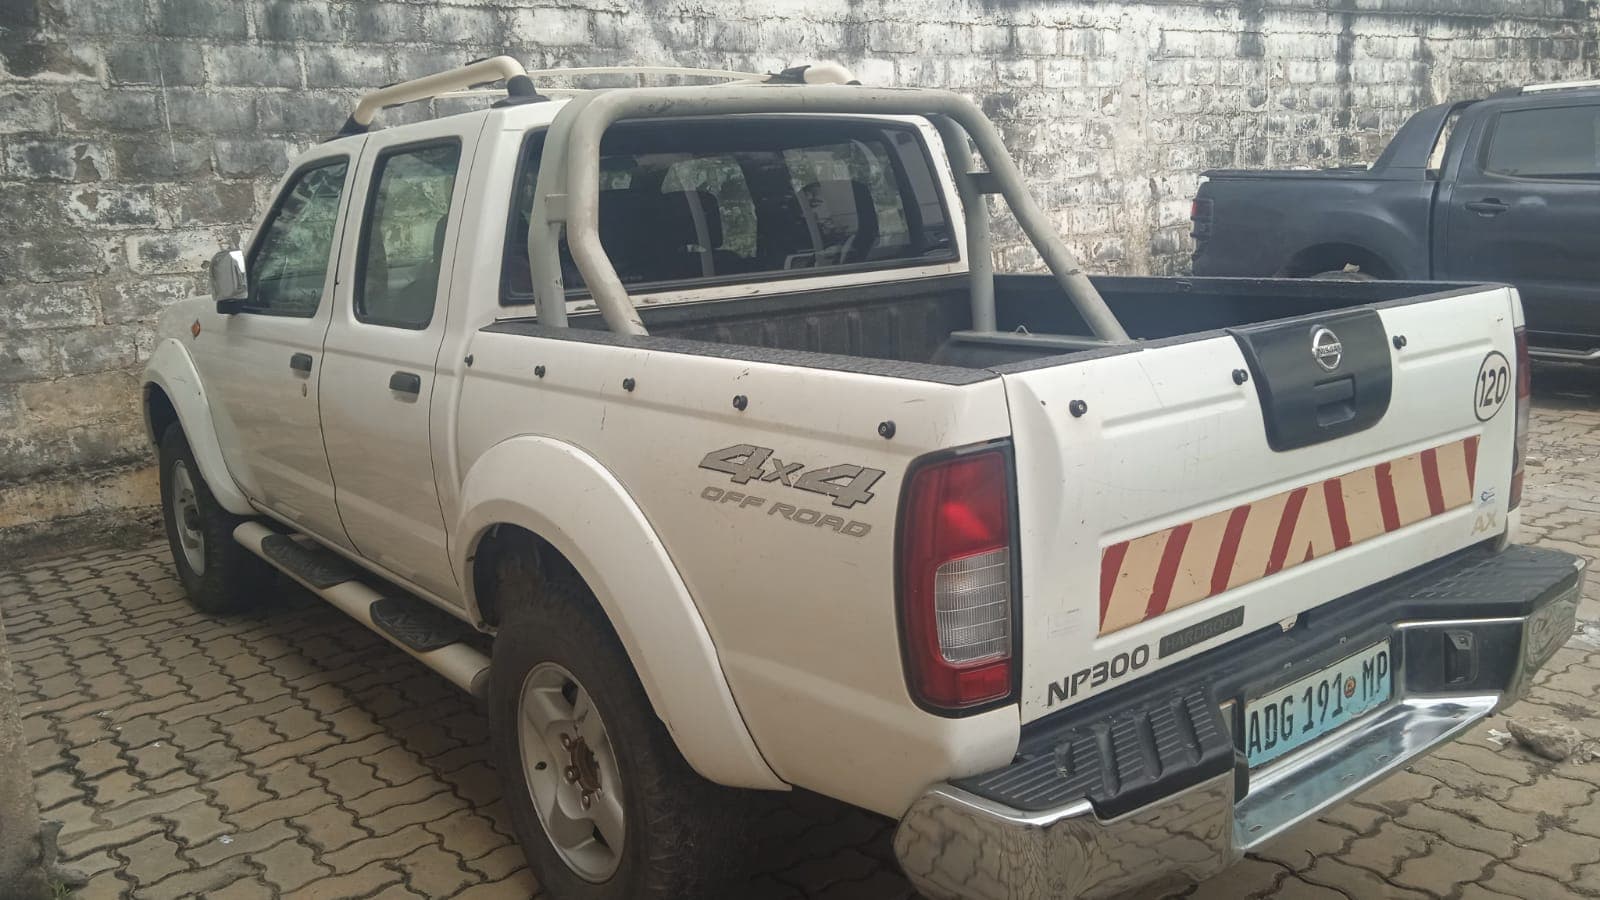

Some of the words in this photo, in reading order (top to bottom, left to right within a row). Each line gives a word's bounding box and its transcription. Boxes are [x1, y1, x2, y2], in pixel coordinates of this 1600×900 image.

[1479, 366, 1507, 408] 120
[701, 486, 766, 508] OFF
[767, 502, 872, 537] ROAD
[1471, 511, 1497, 536] AX
[1047, 644, 1150, 706] NP300
[1248, 695, 1293, 758] ADG
[1302, 672, 1343, 734] 191
[1362, 651, 1387, 701] MP
